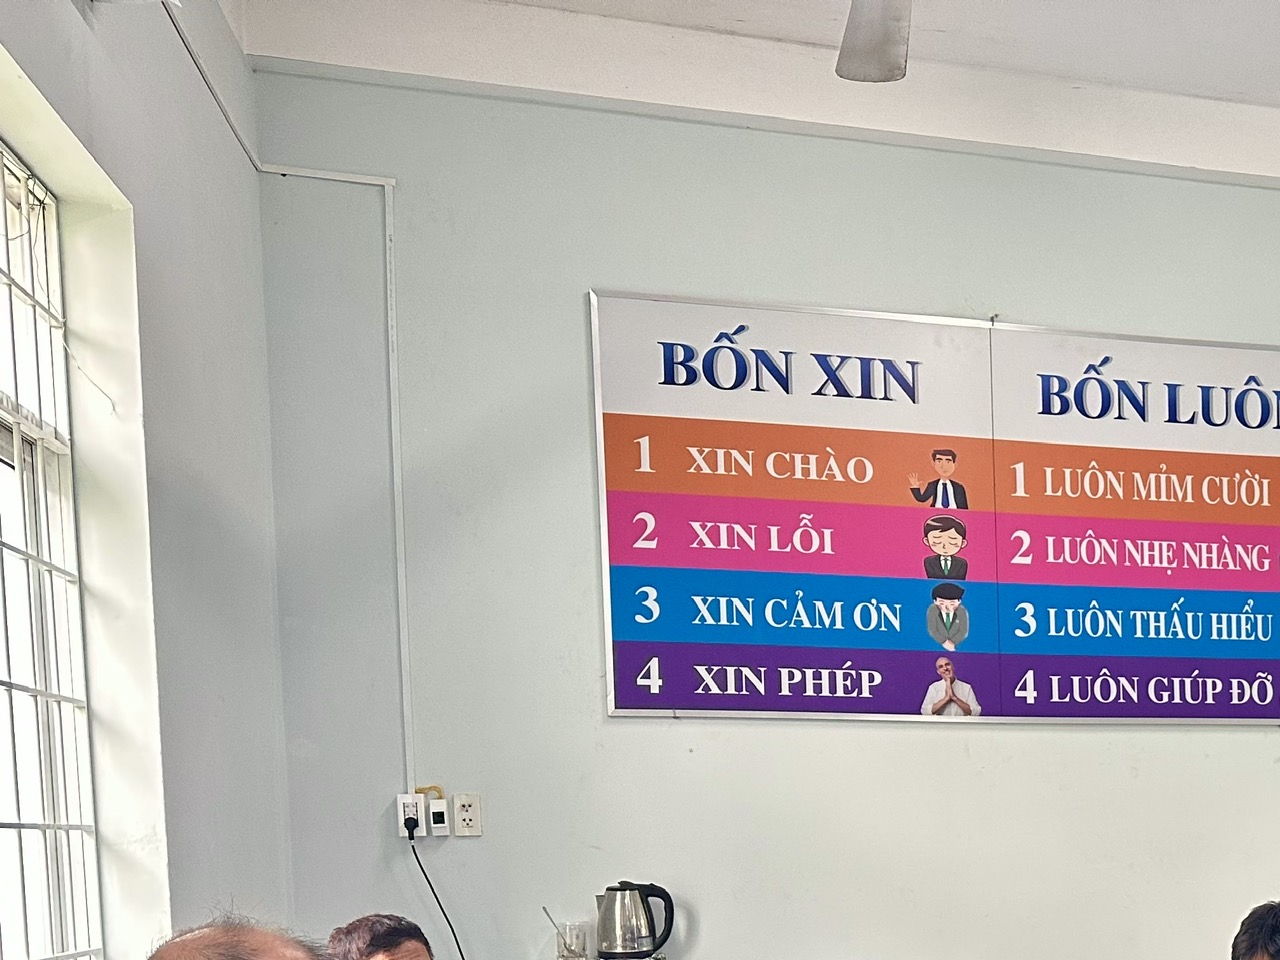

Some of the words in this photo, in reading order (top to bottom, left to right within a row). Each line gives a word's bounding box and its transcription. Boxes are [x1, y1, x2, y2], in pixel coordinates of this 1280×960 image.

[657, 325, 796, 395] BỐN
[810, 353, 922, 404] XIN
[1037, 356, 1149, 423] BỐN
[633, 435, 656, 473] 1
[686, 446, 754, 477] XIN
[766, 447, 873, 483] CHÀO
[1010, 462, 1030, 497] 1
[1044, 461, 1124, 499] LUÔN
[1132, 464, 1194, 503] MỈM
[1202, 469, 1271, 507] CƯỜI
[632, 512, 658, 549] 2
[689, 520, 756, 550] XIN
[768, 514, 834, 555] LỖI
[1010, 530, 1033, 566] 2
[1046, 530, 1119, 565] LUÔN
[1124, 538, 1177, 575] NHẸ
[1182, 536, 1271, 571] NHÀNG
[635, 586, 661, 623] 3
[692, 595, 754, 626] XIN
[765, 591, 843, 630] CẢM
[853, 602, 902, 632] ƠN
[1014, 602, 1037, 638] 3
[1048, 600, 1123, 638] LUÔN
[1130, 598, 1203, 640] THẤU
[1210, 600, 1273, 641] HIỂU
[636, 657, 663, 694] 4
[694, 665, 766, 695] XIN
[778, 661, 882, 698] PHÉP
[1014, 670, 1038, 704] 4
[1049, 668, 1139, 704] LUÔN
[1148, 669, 1222, 705] GIÚP
[1229, 672, 1274, 706] ĐỠ
